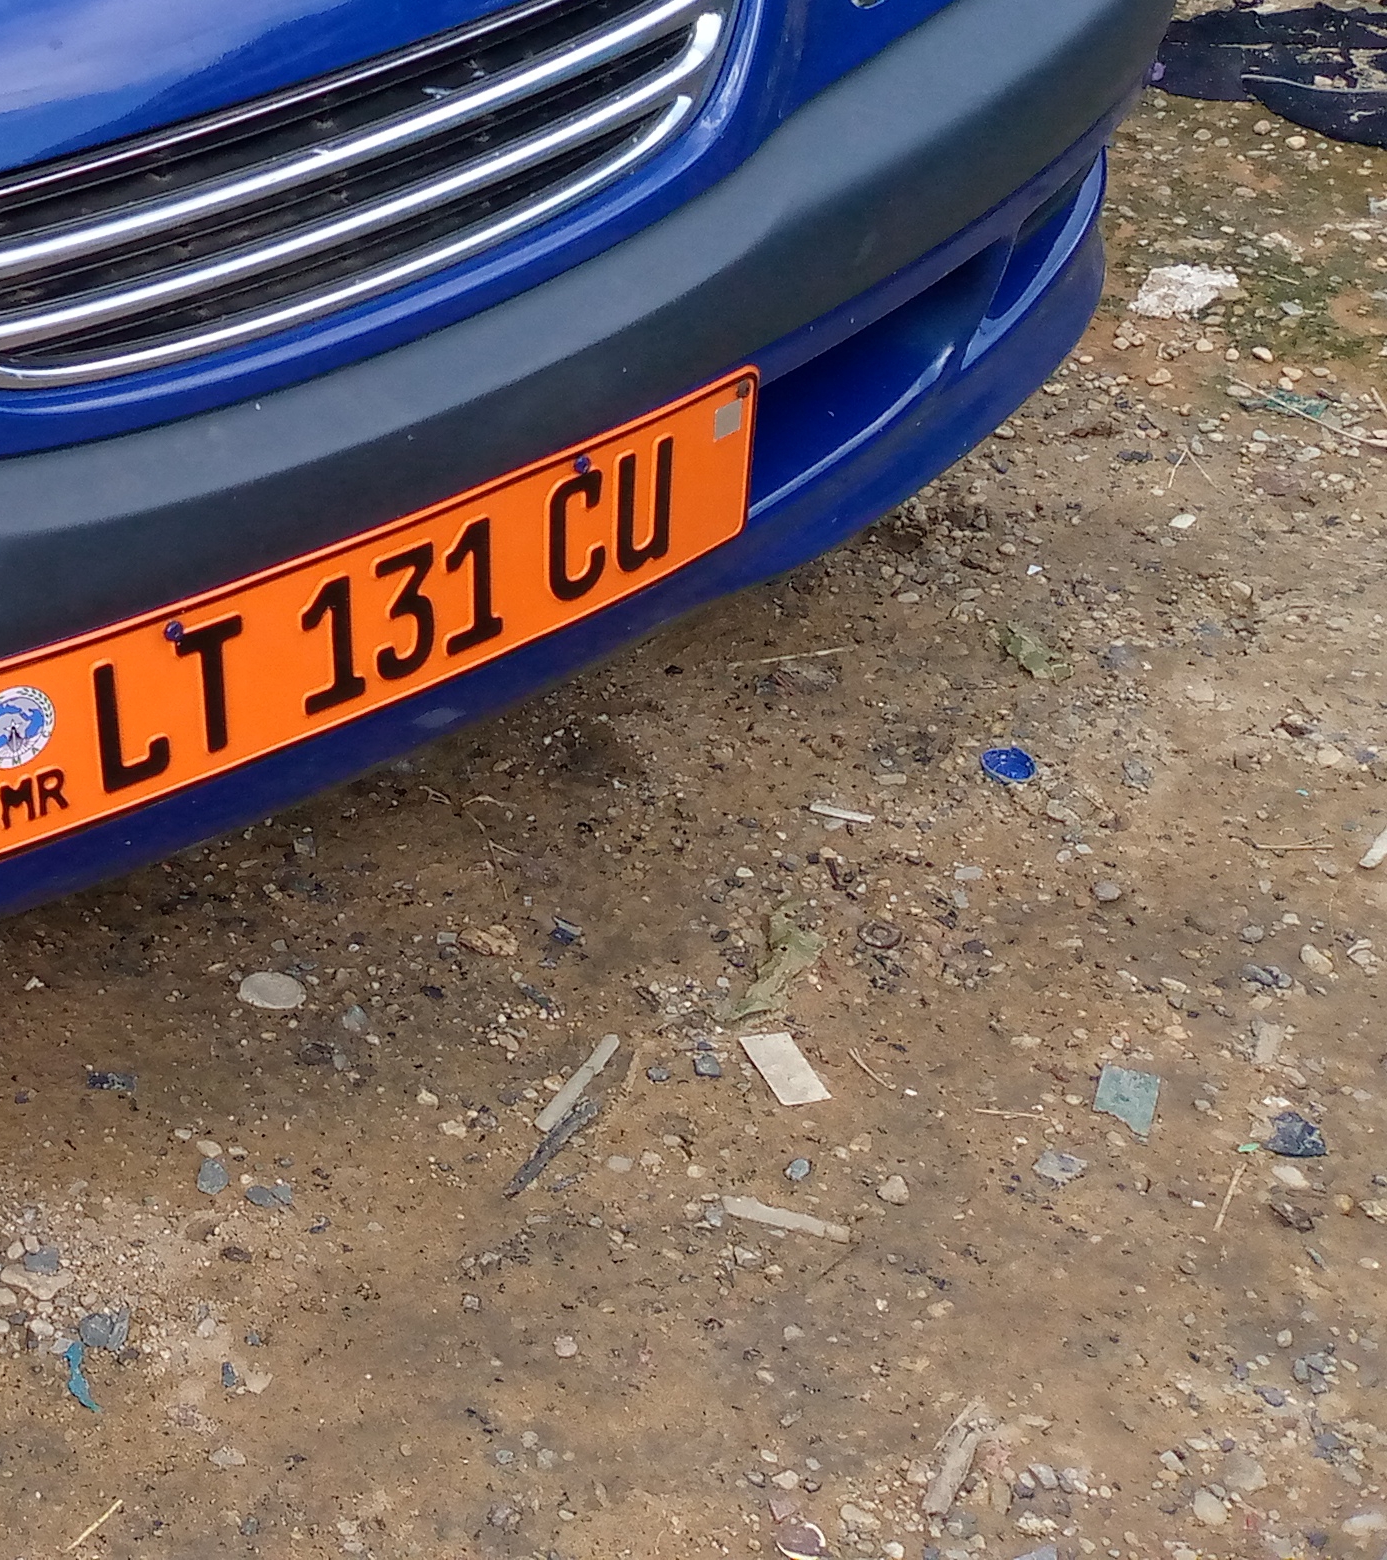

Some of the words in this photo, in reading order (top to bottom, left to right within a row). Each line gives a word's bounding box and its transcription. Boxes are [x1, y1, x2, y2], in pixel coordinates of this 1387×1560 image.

[94, 616, 243, 793] LT
[301, 518, 504, 715] 131
[548, 436, 675, 601] CU
